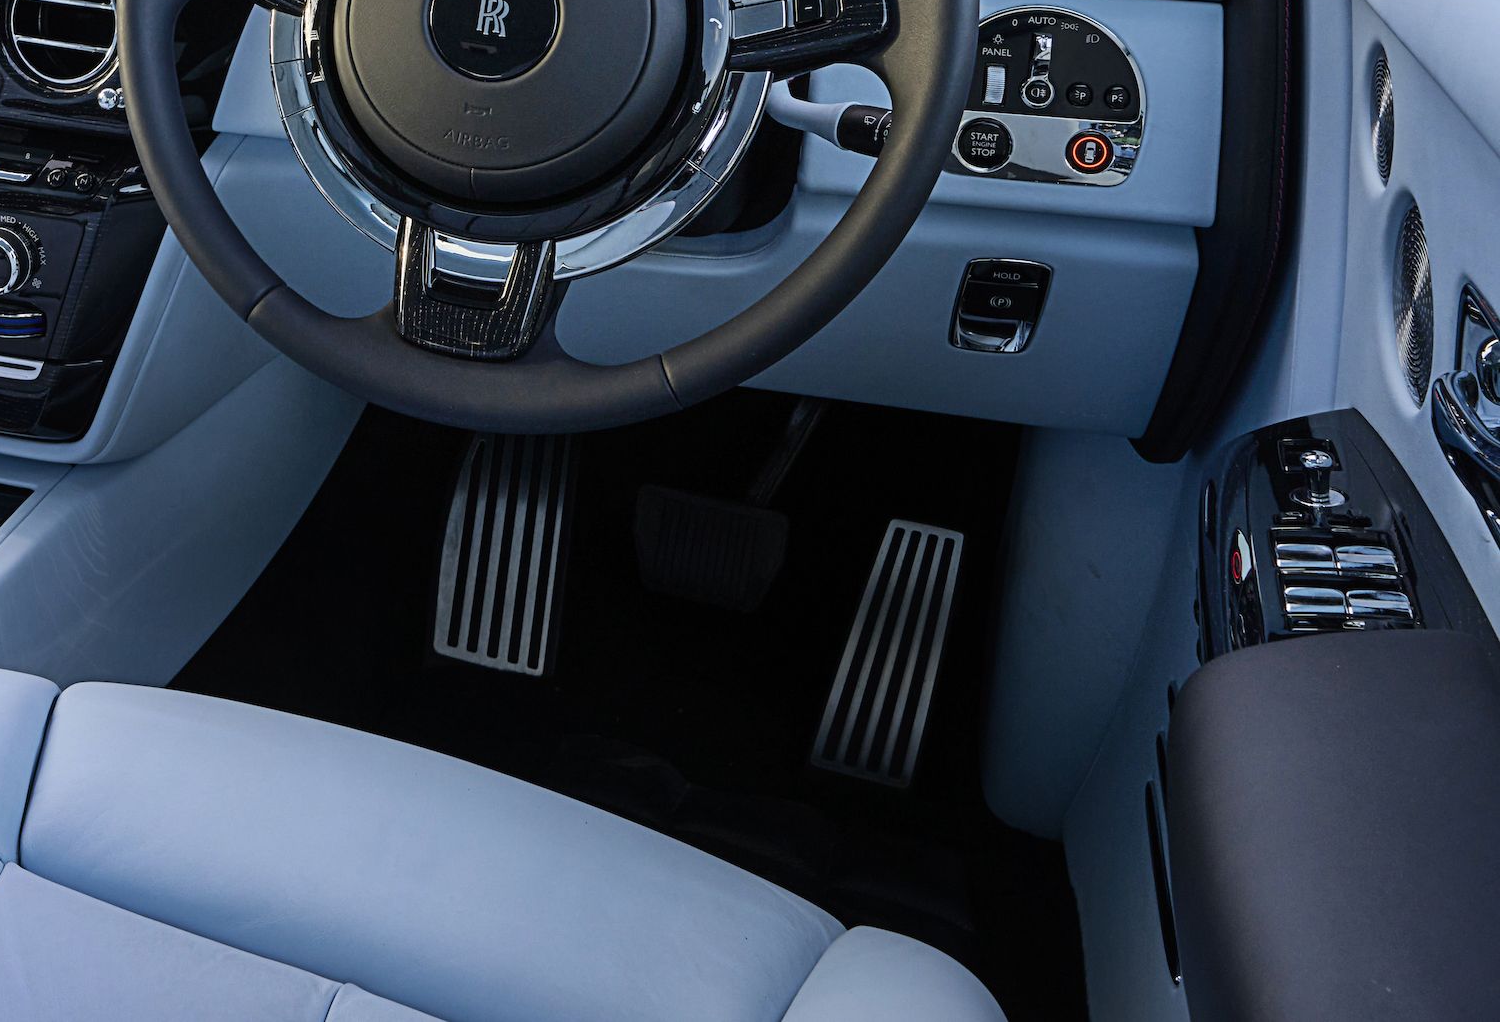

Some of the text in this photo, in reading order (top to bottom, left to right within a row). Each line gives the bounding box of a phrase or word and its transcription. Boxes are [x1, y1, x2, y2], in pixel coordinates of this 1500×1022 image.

[1027, 16, 1057, 26] AUTO
[981, 47, 1012, 57] PANEL
[443, 128, 511, 151] AIRBAG
[970, 132, 999, 142] START
[24, 152, 31, 160] 8
[971, 147, 996, 157] STOP
[0, 215, 16, 224] MED
[22, 223, 40, 242] HIGH
[37, 246, 47, 266] MAX
[993, 271, 1021, 281] HOLD
